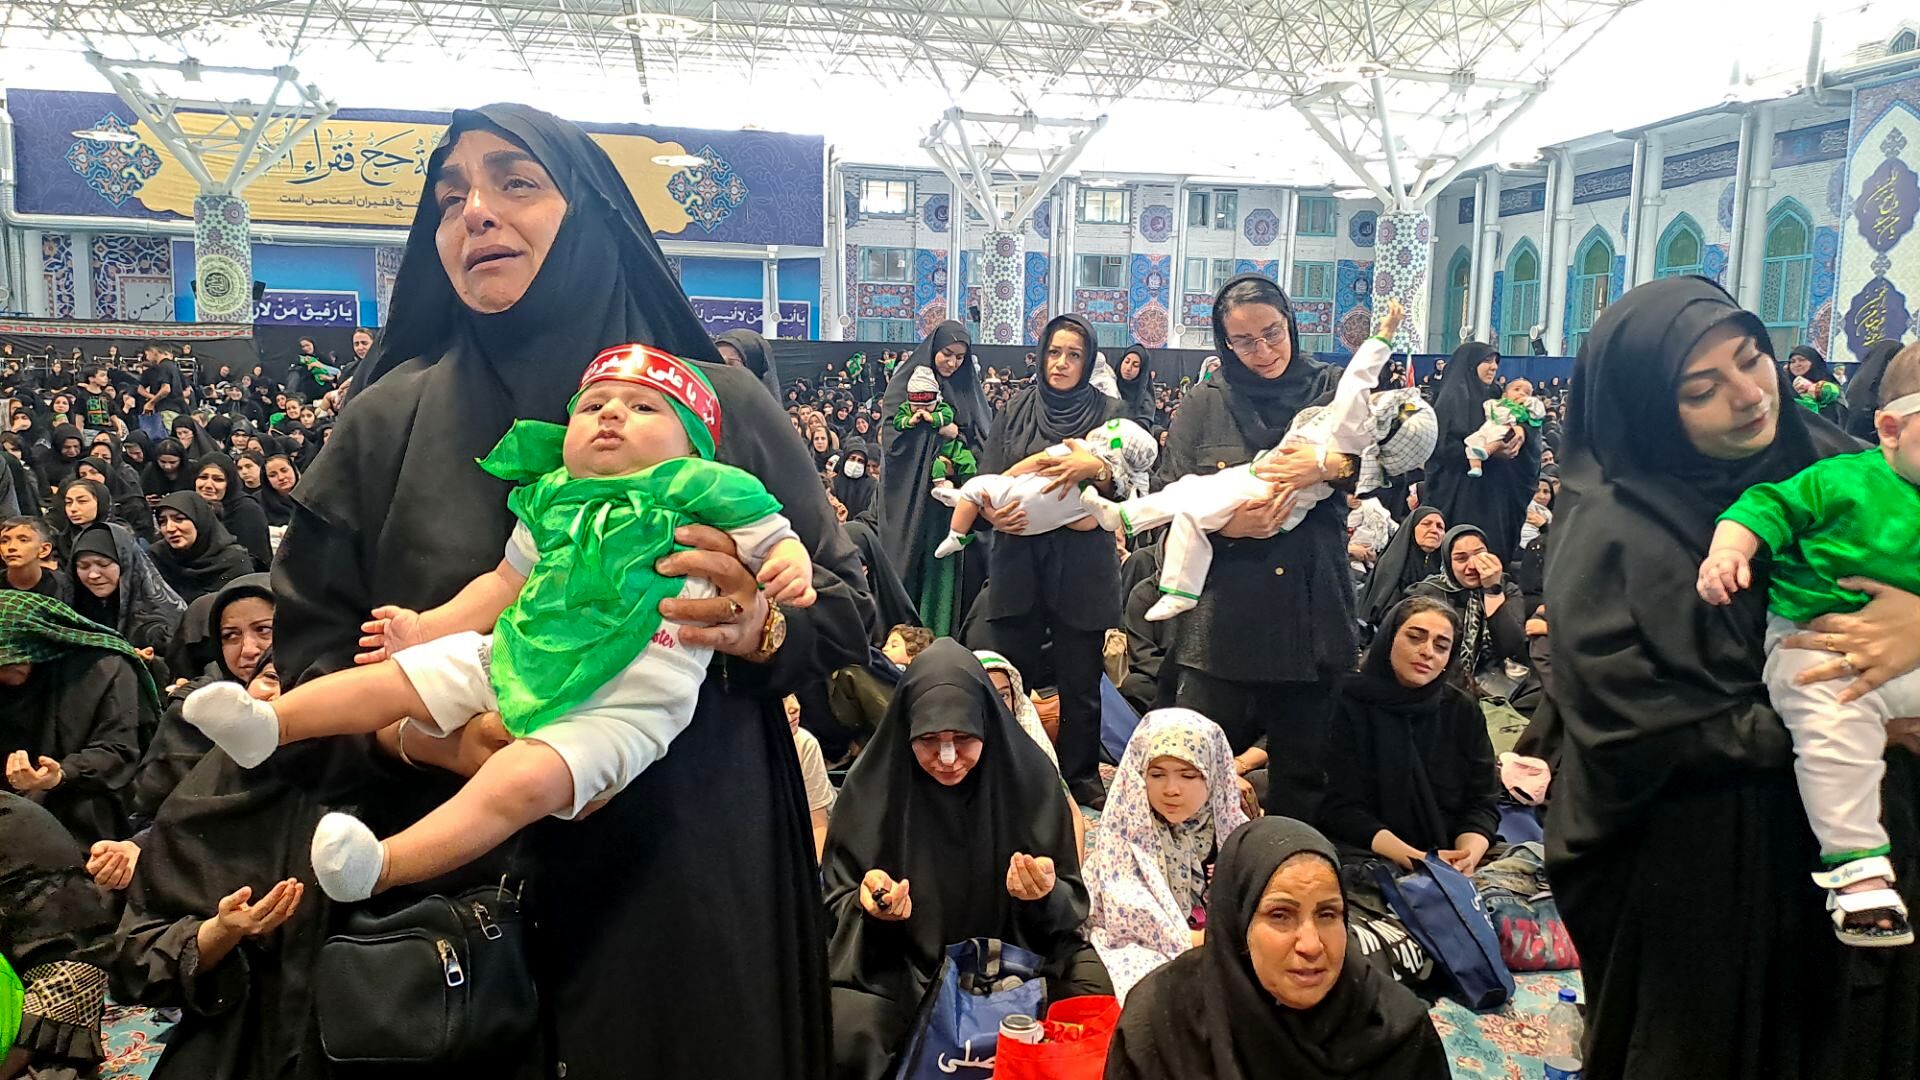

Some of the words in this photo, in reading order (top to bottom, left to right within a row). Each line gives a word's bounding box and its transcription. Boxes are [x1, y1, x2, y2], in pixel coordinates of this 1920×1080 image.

[305, 196, 328, 206] من
[329, 195, 355, 205] امت
[356, 195, 395, 208] فقیران
